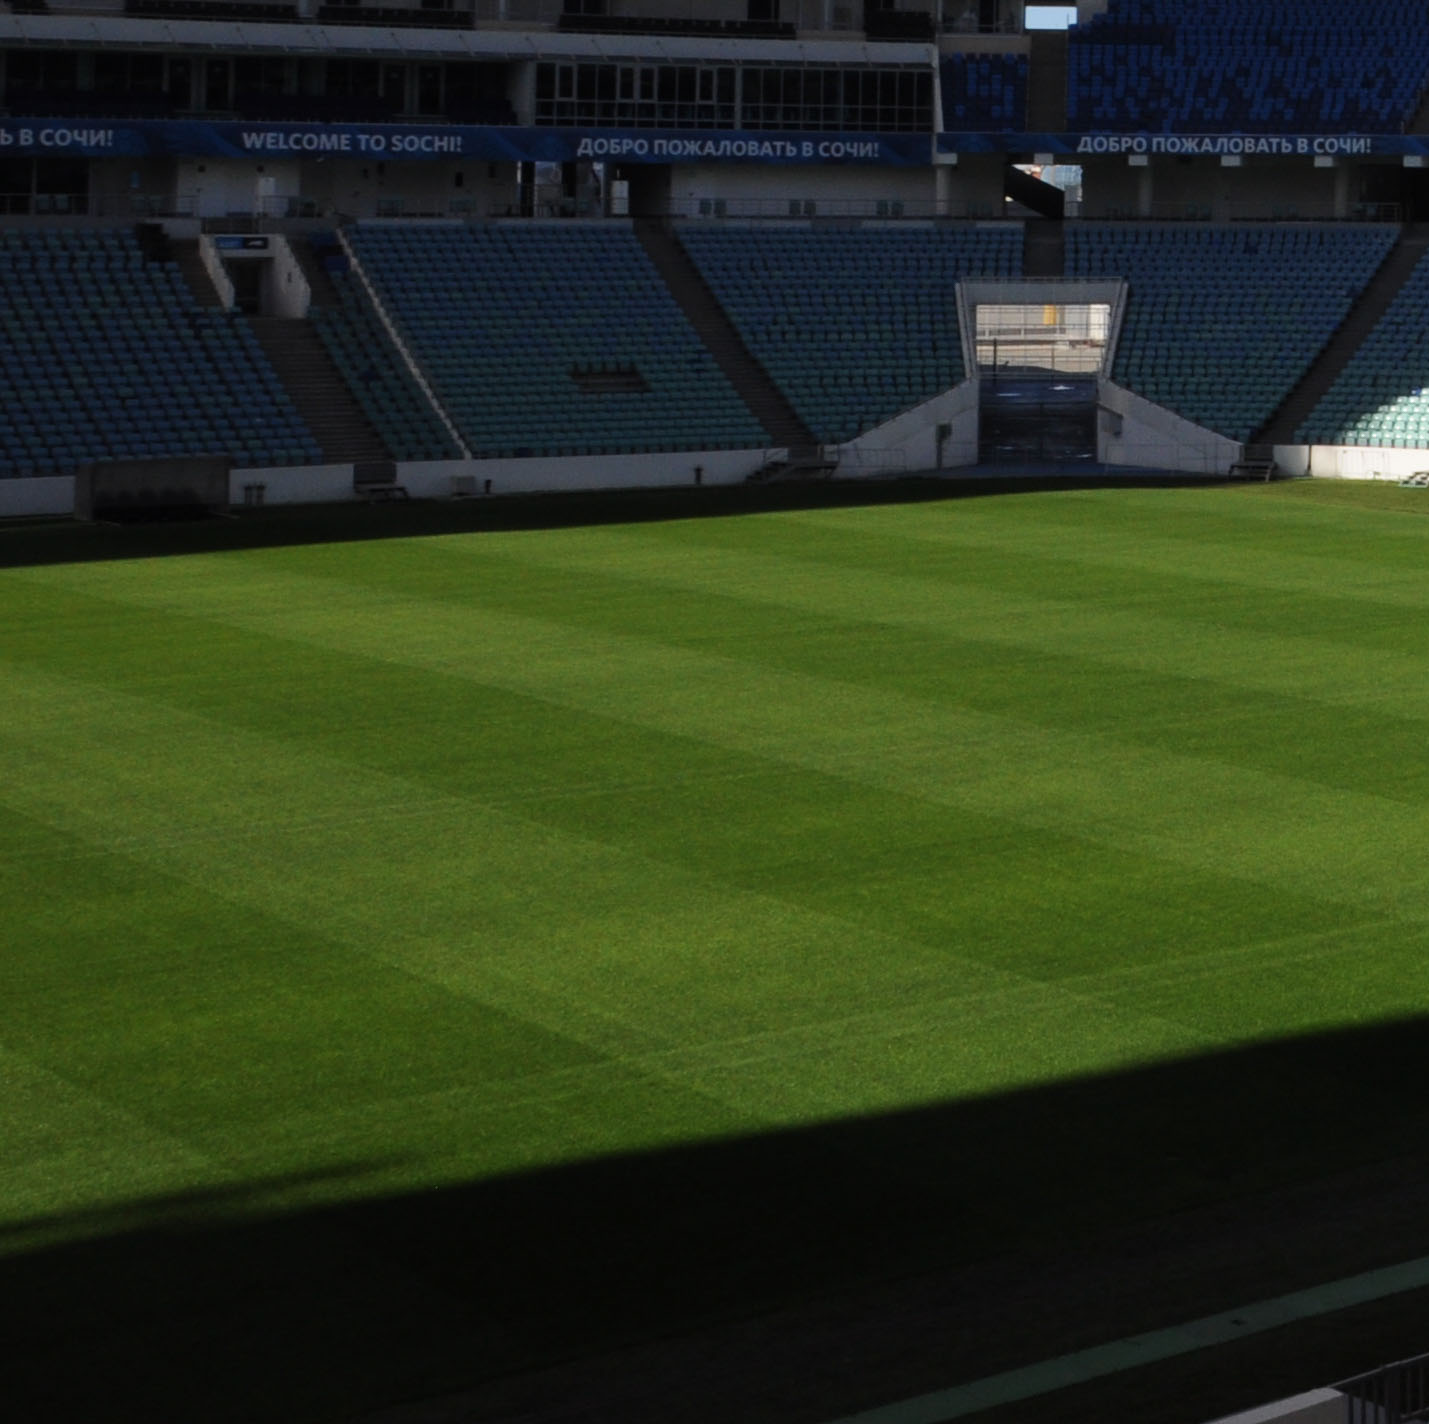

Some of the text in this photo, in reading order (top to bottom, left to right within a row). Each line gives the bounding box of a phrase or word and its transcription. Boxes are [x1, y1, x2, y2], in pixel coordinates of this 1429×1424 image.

[20, 130, 34, 146] В
[40, 129, 114, 147] СОЧИ!
[242, 132, 462, 153] WELCOME TO SOCHI!
[1076, 136, 1372, 154] ДОБРО ПОЖАЛОВАТЬ В СОЧИ!
[577, 138, 880, 158] ДОБРО ПОЖАЛОВАТЬ В СОЧИ!
